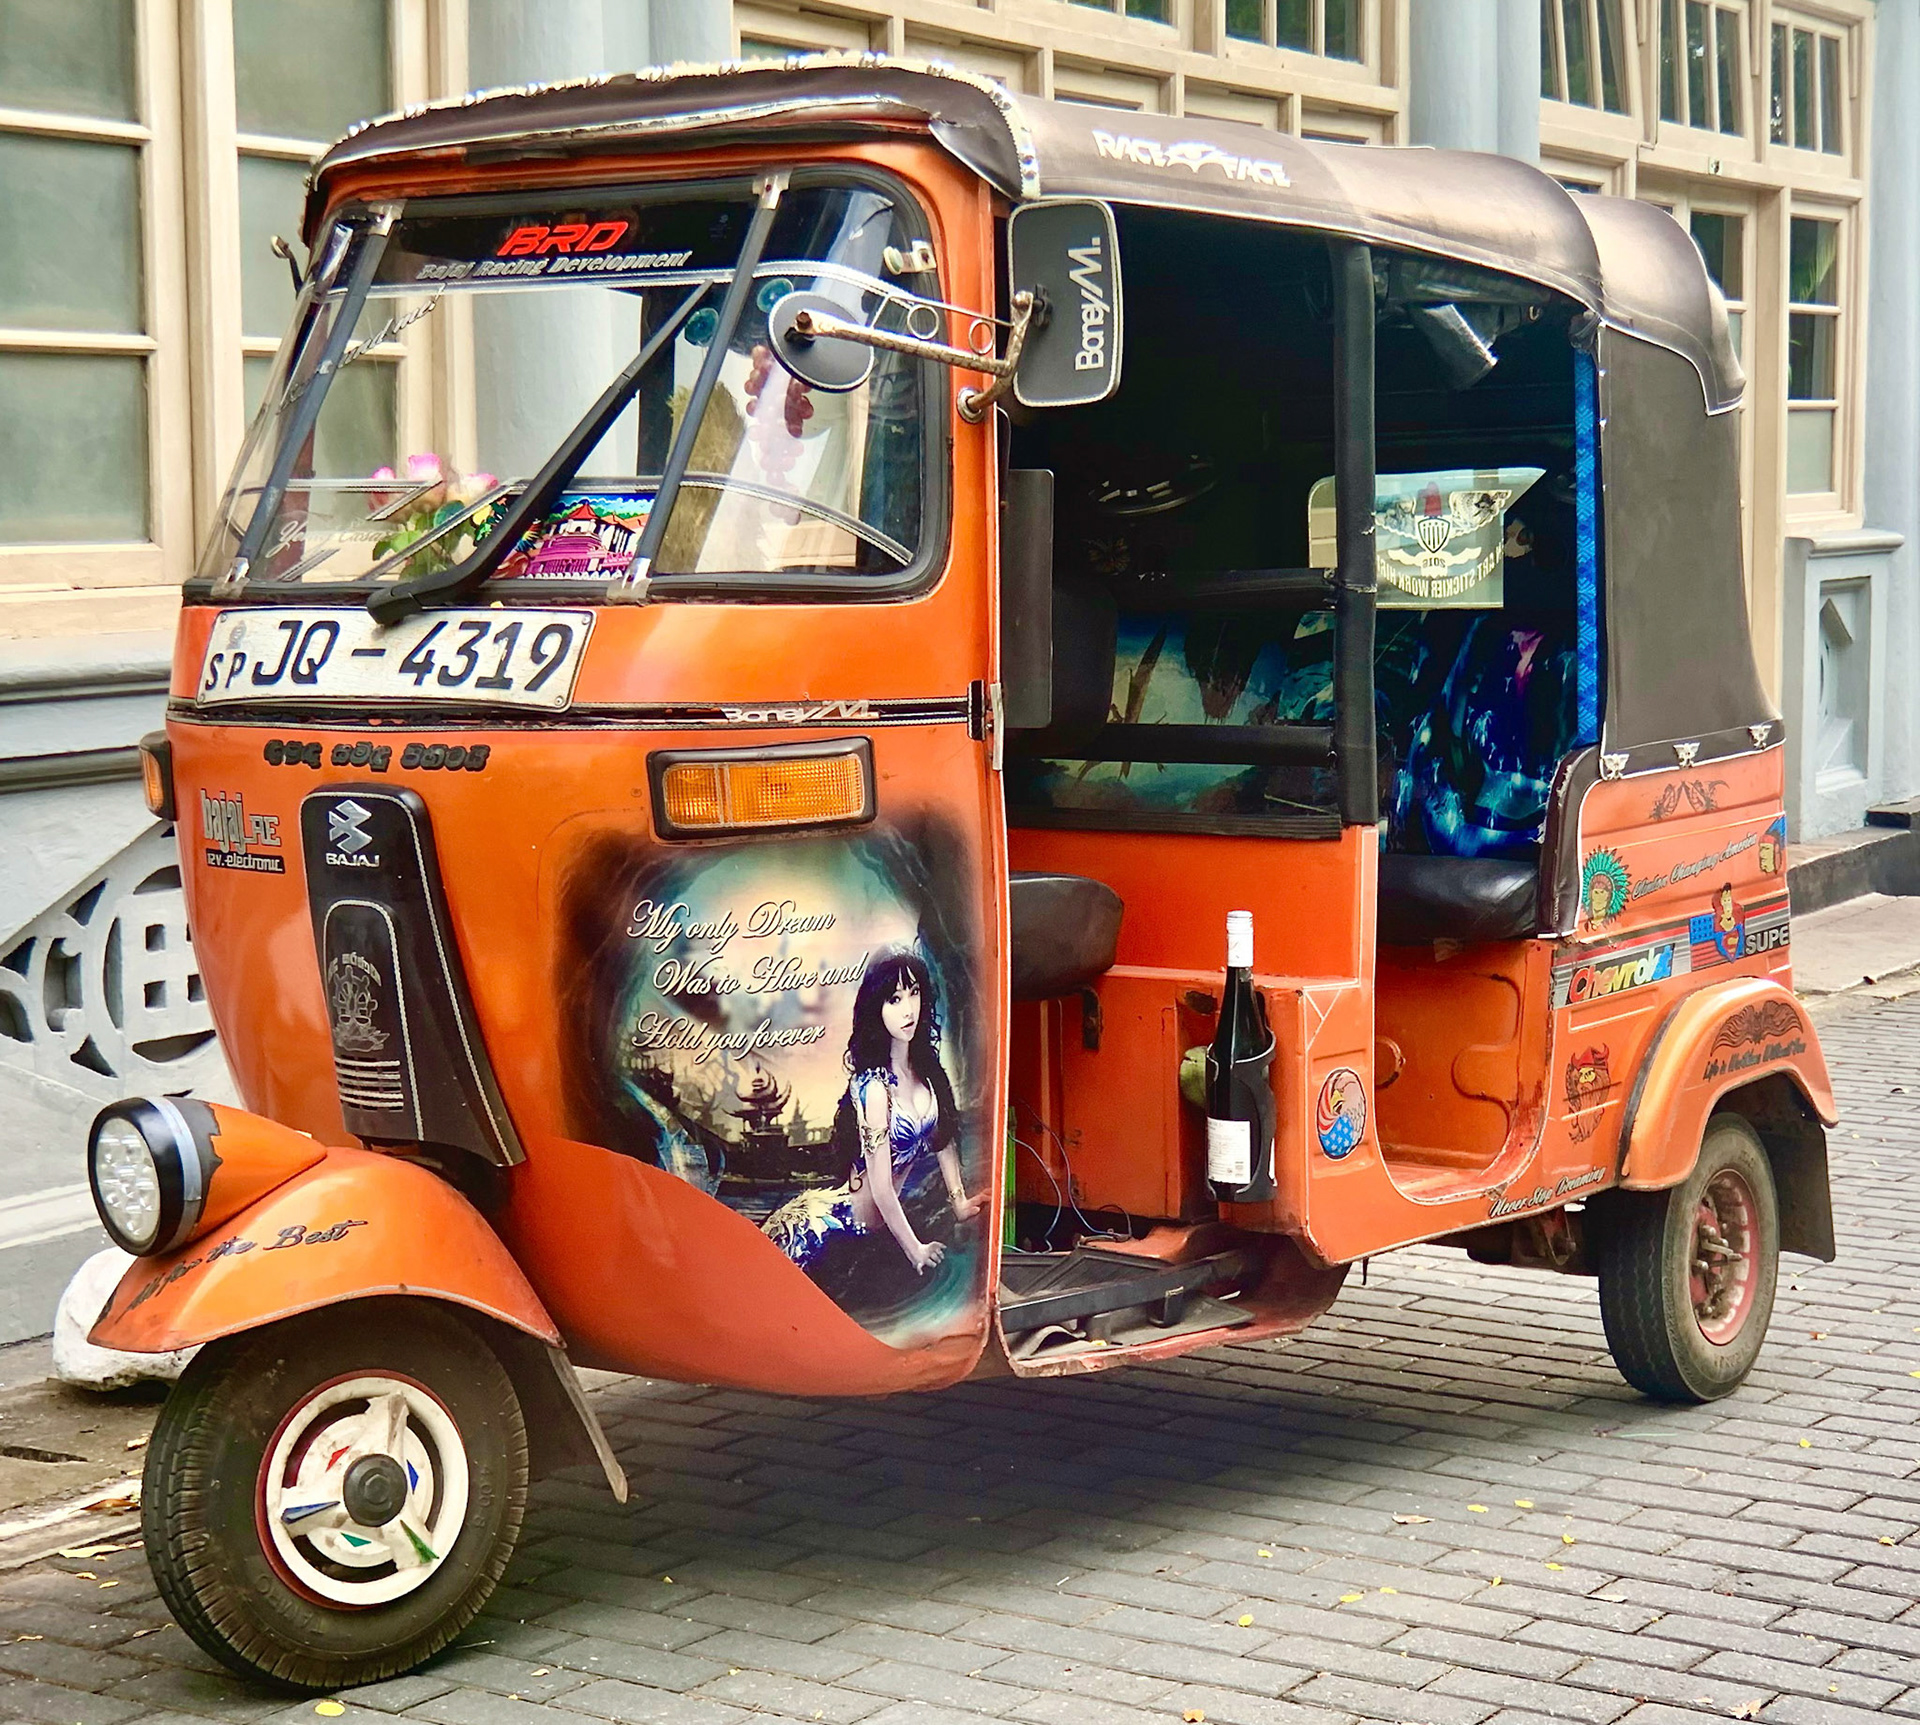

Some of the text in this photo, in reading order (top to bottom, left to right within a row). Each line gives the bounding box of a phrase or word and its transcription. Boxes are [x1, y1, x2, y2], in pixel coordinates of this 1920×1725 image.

[1092, 129, 1169, 168] RACE
[497, 221, 629, 256] BRD
[416, 250, 693, 280] Bajaj Racing Development
[1075, 291, 1110, 371] Boney
[206, 652, 246, 692] SP
[252, 620, 341, 687] JQ
[399, 620, 574, 693] 4319
[201, 788, 247, 855] bajaj
[326, 852, 380, 868] BAJAJ
[1670, 853, 1720, 885] Changing
[627, 900, 836, 953] My only Dream
[653, 951, 869, 996] Was to Have and
[632, 1012, 825, 1064] Hold you forever
[1489, 1166, 1606, 1219] Never Stop Dreaming
[263, 1220, 368, 1251] Best
